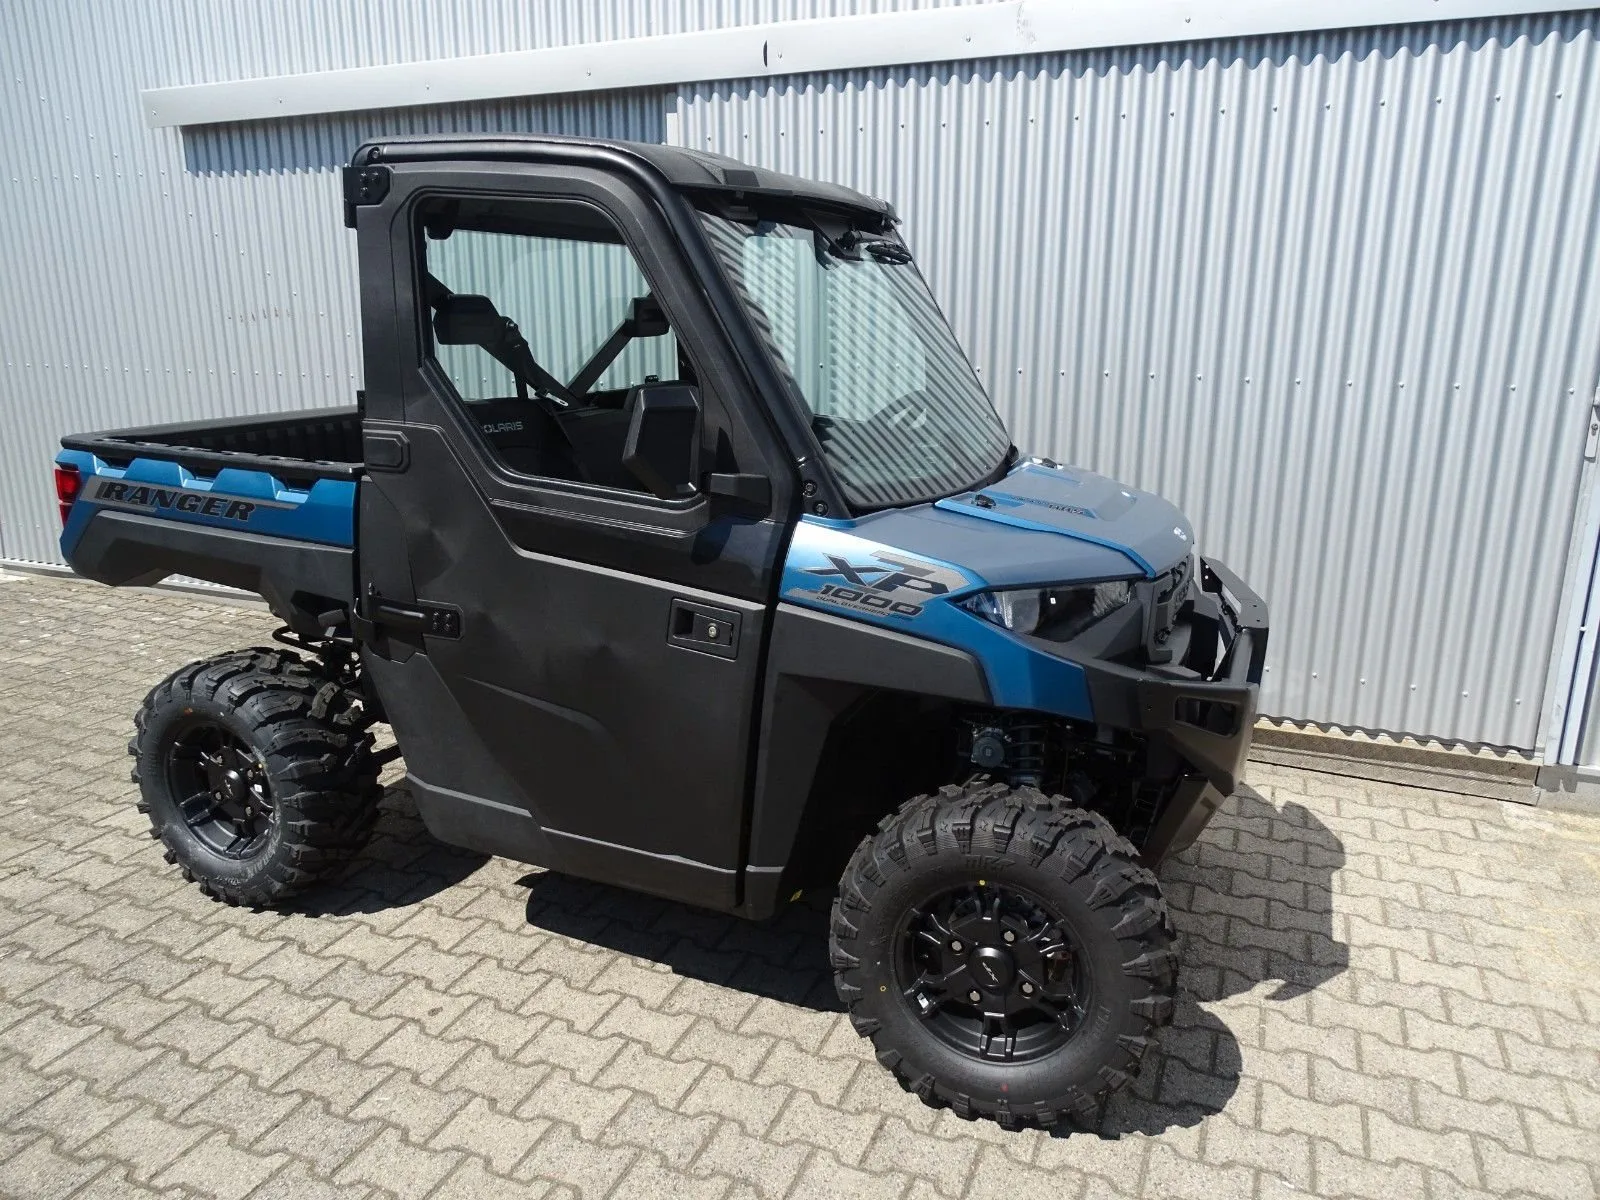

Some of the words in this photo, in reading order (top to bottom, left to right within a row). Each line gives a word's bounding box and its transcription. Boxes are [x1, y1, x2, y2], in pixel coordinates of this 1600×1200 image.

[481, 421, 523, 434] OLARIS
[96, 481, 256, 522] RANGER
[800, 553, 951, 595] XP
[819, 584, 923, 615] 1000
